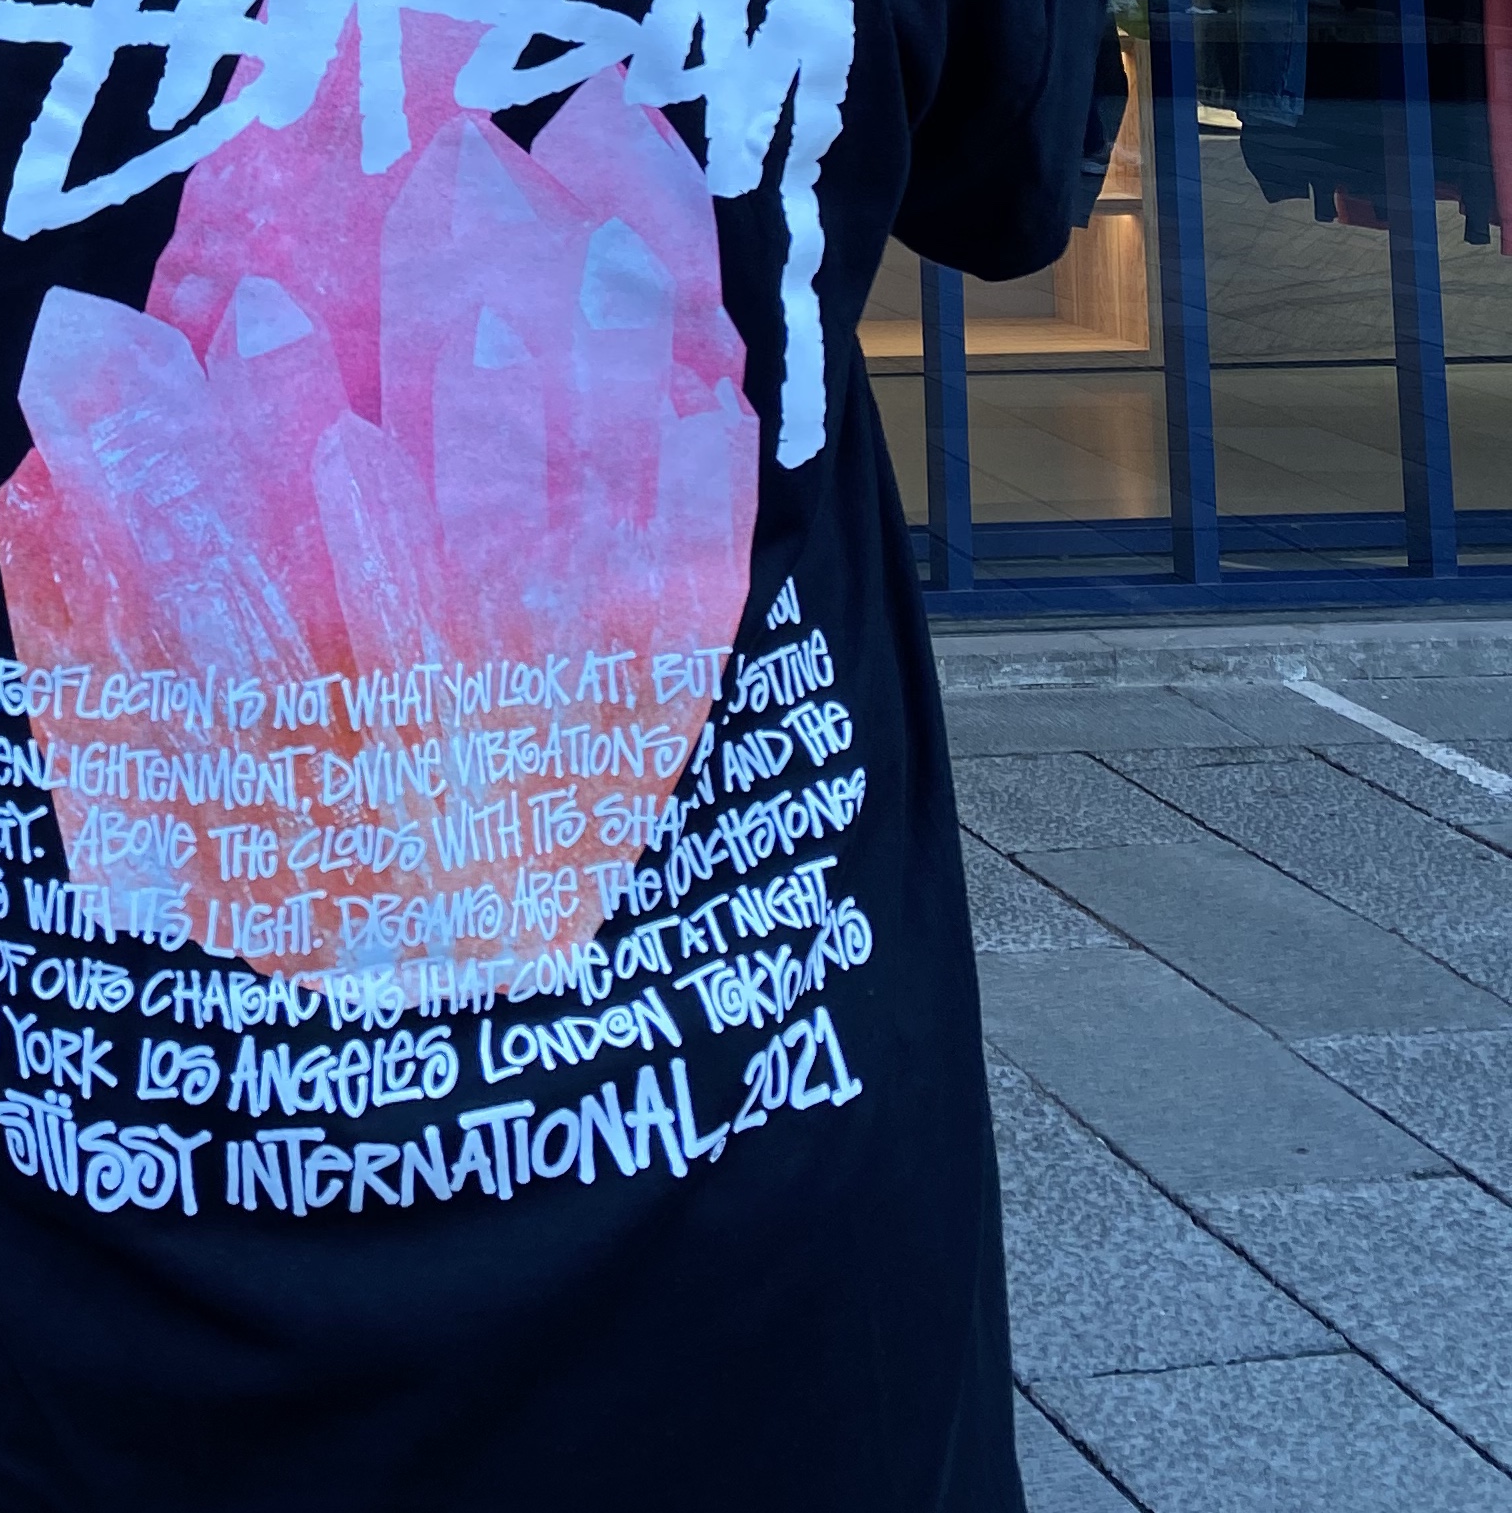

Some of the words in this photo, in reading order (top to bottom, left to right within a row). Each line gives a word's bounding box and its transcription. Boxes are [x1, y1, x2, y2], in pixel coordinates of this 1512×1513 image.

[225, 675, 267, 733] IS
[273, 672, 343, 732] NOT
[341, 662, 444, 732] WHAT
[443, 662, 494, 729] YOU
[497, 653, 573, 710] LOOK
[651, 645, 734, 705] BUT
[286, 820, 427, 875] CLOUDS
[432, 790, 524, 873] WITH
[721, 727, 795, 794] AND
[453, 719, 688, 787] VIBRATIONS
[23, 877, 118, 945] WITH
[31, 957, 135, 1014] OUR
[402, 956, 514, 1018] THAT
[614, 914, 682, 980] OUT
[679, 892, 731, 960] AT
[2, 1005, 119, 1100] YORK
[136, 1036, 222, 1106] LOS
[479, 986, 684, 1085] LONDON
[225, 1056, 731, 1219] INTERNATIONAL
[733, 1005, 864, 1135] 2021
